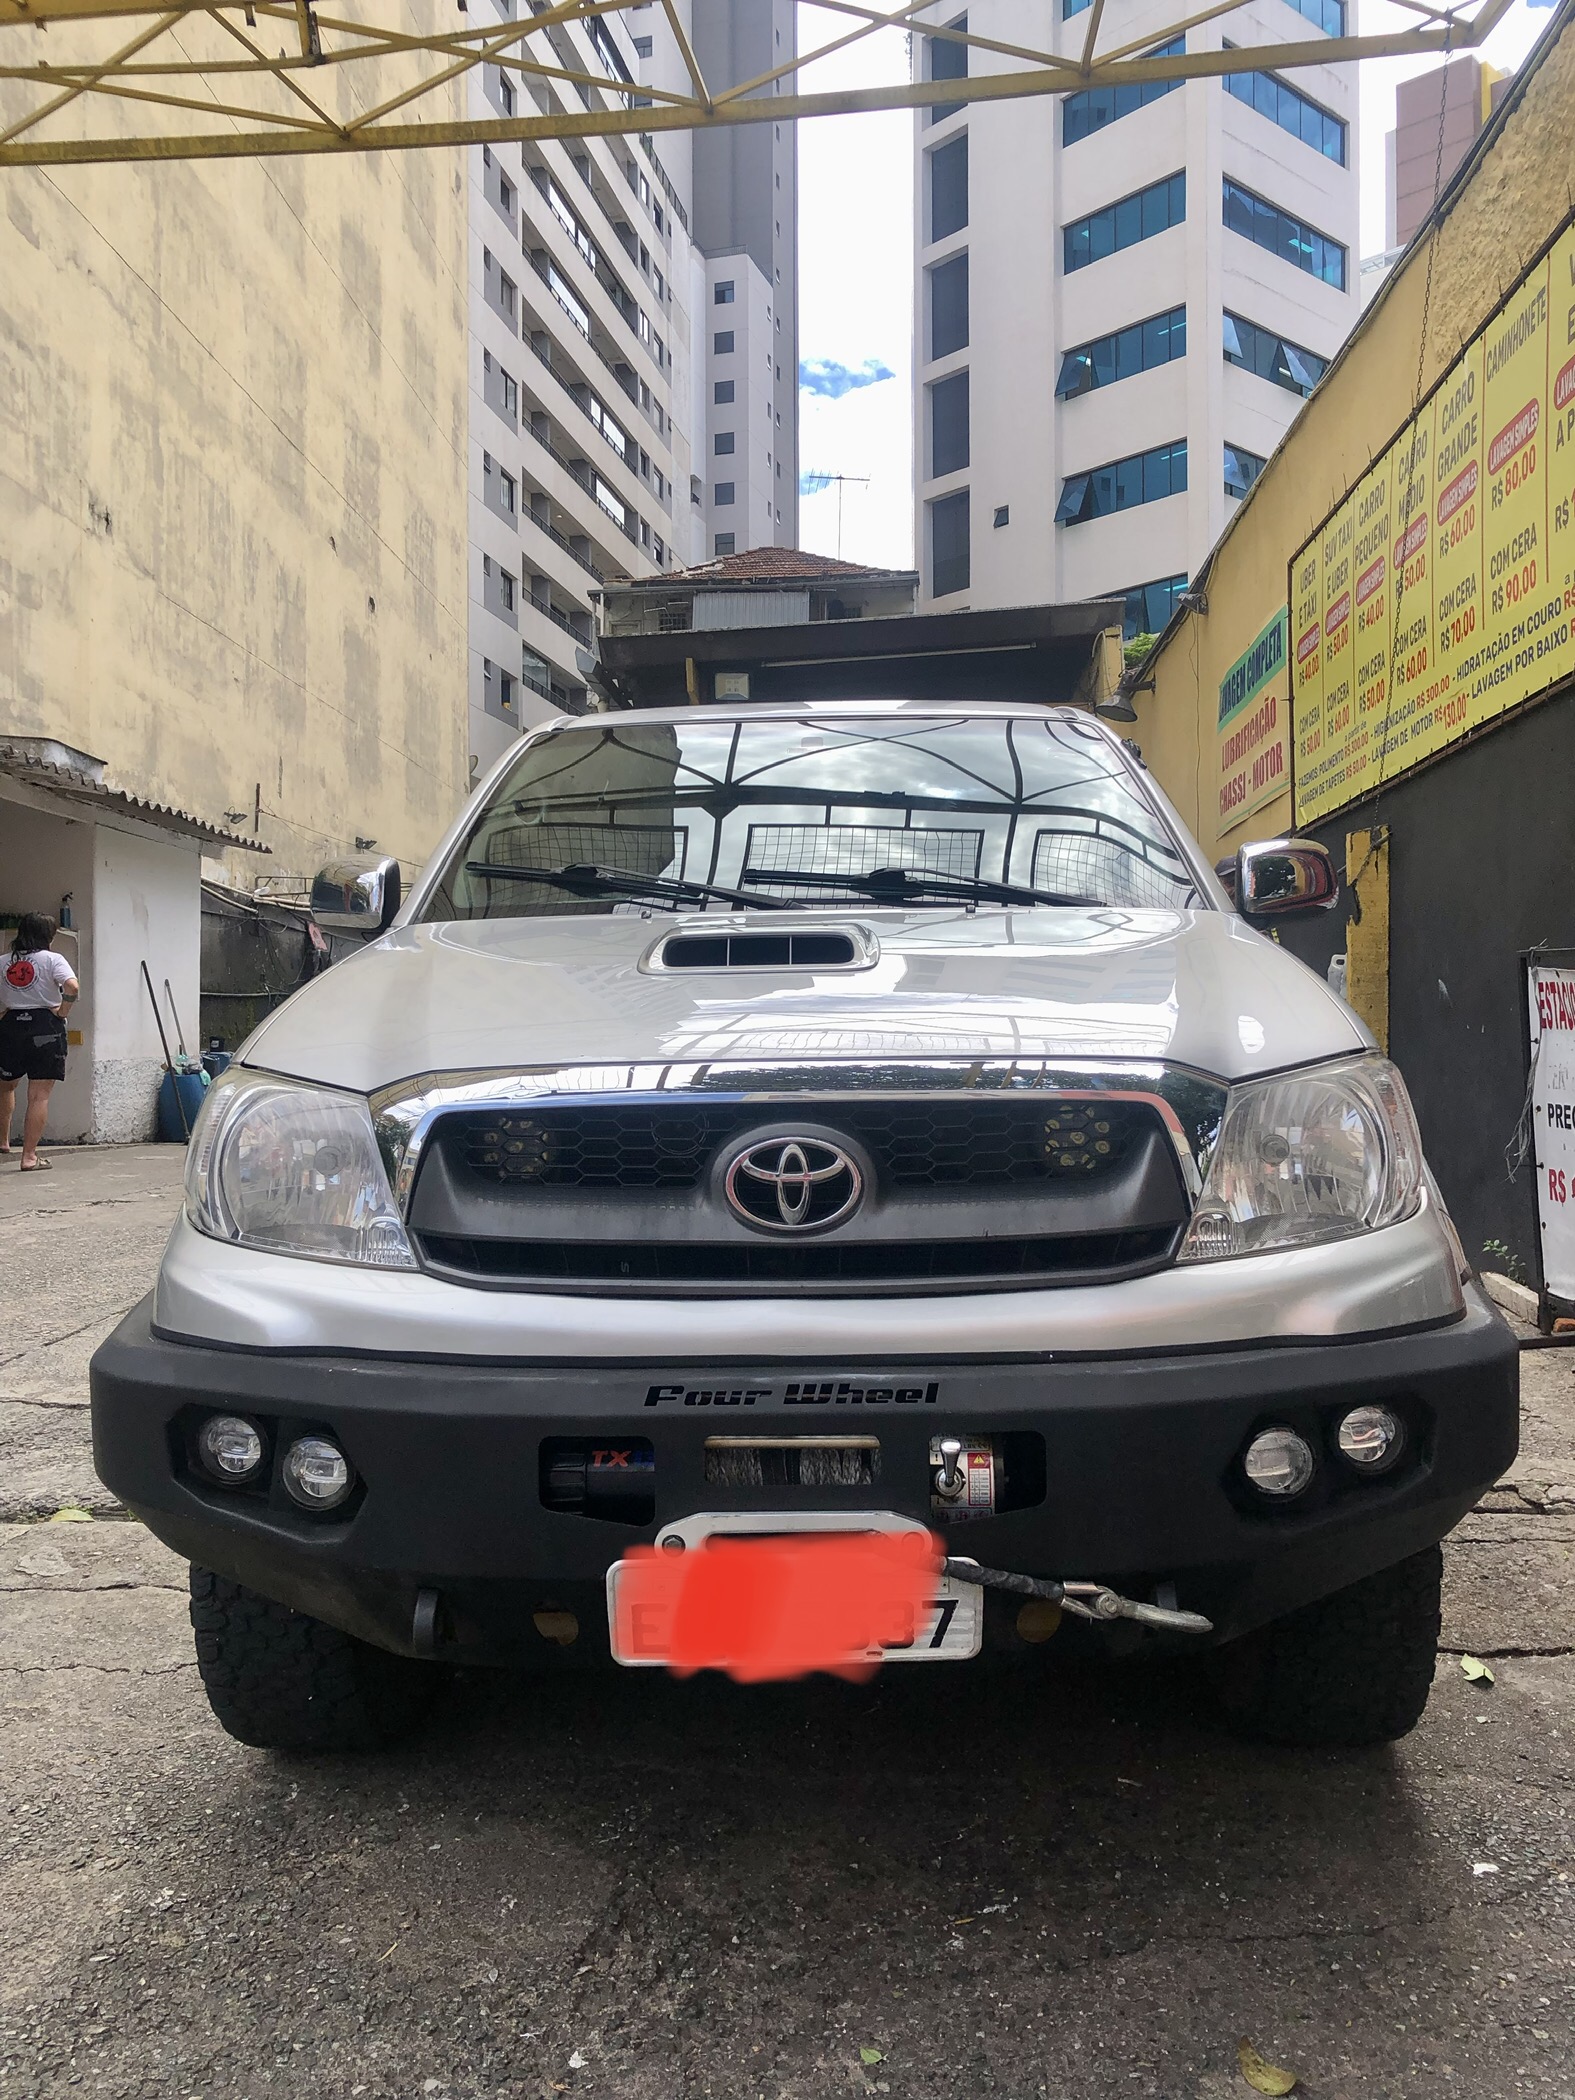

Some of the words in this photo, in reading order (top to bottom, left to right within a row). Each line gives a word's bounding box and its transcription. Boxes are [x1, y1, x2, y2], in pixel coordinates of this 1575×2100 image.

[1486, 285, 1546, 383] CAMINHONETE
[1442, 371, 1474, 435] CARRO
[1399, 430, 1427, 485] CARO
[1438, 412, 1477, 482] GRANDE
[1490, 427, 1514, 471] LAVAGEM
[1515, 404, 1538, 446] SIMPLES
[1556, 419, 1564, 452] A
[1359, 479, 1385, 527] CARRO
[1399, 474, 1425, 525] MDIO
[1491, 477, 1503, 511] R$
[1505, 444, 1536, 496] 80,00
[1440, 530, 1449, 558] R$
[1450, 504, 1475, 547] 60,00
[1555, 496, 1569, 533] R$
[1325, 531, 1337, 567] SUV
[1355, 513, 1388, 570] PEQUENO
[1490, 543, 1509, 580] COM
[1511, 522, 1537, 563] CERA
[1300, 559, 1316, 594] UBER
[1327, 575, 1331, 600] E
[1332, 557, 1348, 595] UBER
[1439, 590, 1454, 622] COM
[1455, 572, 1476, 608] CERA
[1492, 583, 1503, 615] R$
[1506, 559, 1536, 607] 90,00
[1396, 630, 1408, 657] COM
[1410, 615, 1427, 646] CERA
[1416, 690, 1425, 710] R$
[1426, 675, 1449, 703] 300,00
[1457, 632, 1509, 682] HIDRATAÇÃO
[1512, 621, 1525, 645] EM
[1527, 597, 1561, 635] COURO
[1440, 624, 1450, 653] R$
[1451, 605, 1475, 648] 70,00
[1247, 620, 1281, 693] COMPLETA
[1358, 662, 1369, 687] COM
[1370, 650, 1385, 678] CERA
[1397, 661, 1405, 686] R$
[1406, 647, 1427, 682] 60,00
[1326, 769, 1345, 790] TAPETES
[1400, 727, 1408, 746] DE
[1410, 712, 1433, 739] MOTOR
[1472, 659, 1512, 699] LAVAGEM
[1515, 646, 1534, 673] POR
[1536, 624, 1567, 659] BAIXO
[1337, 680, 1349, 705] CERA
[1367, 678, 1384, 711] 50,00
[1222, 696, 1276, 772] LUBRIFICAÇÃO
[1252, 741, 1283, 792] MOTOR
[1549, 1169, 1566, 1207] R$
[644, 1385, 772, 1406] Four
[783, 1383, 939, 1405] Wheel
